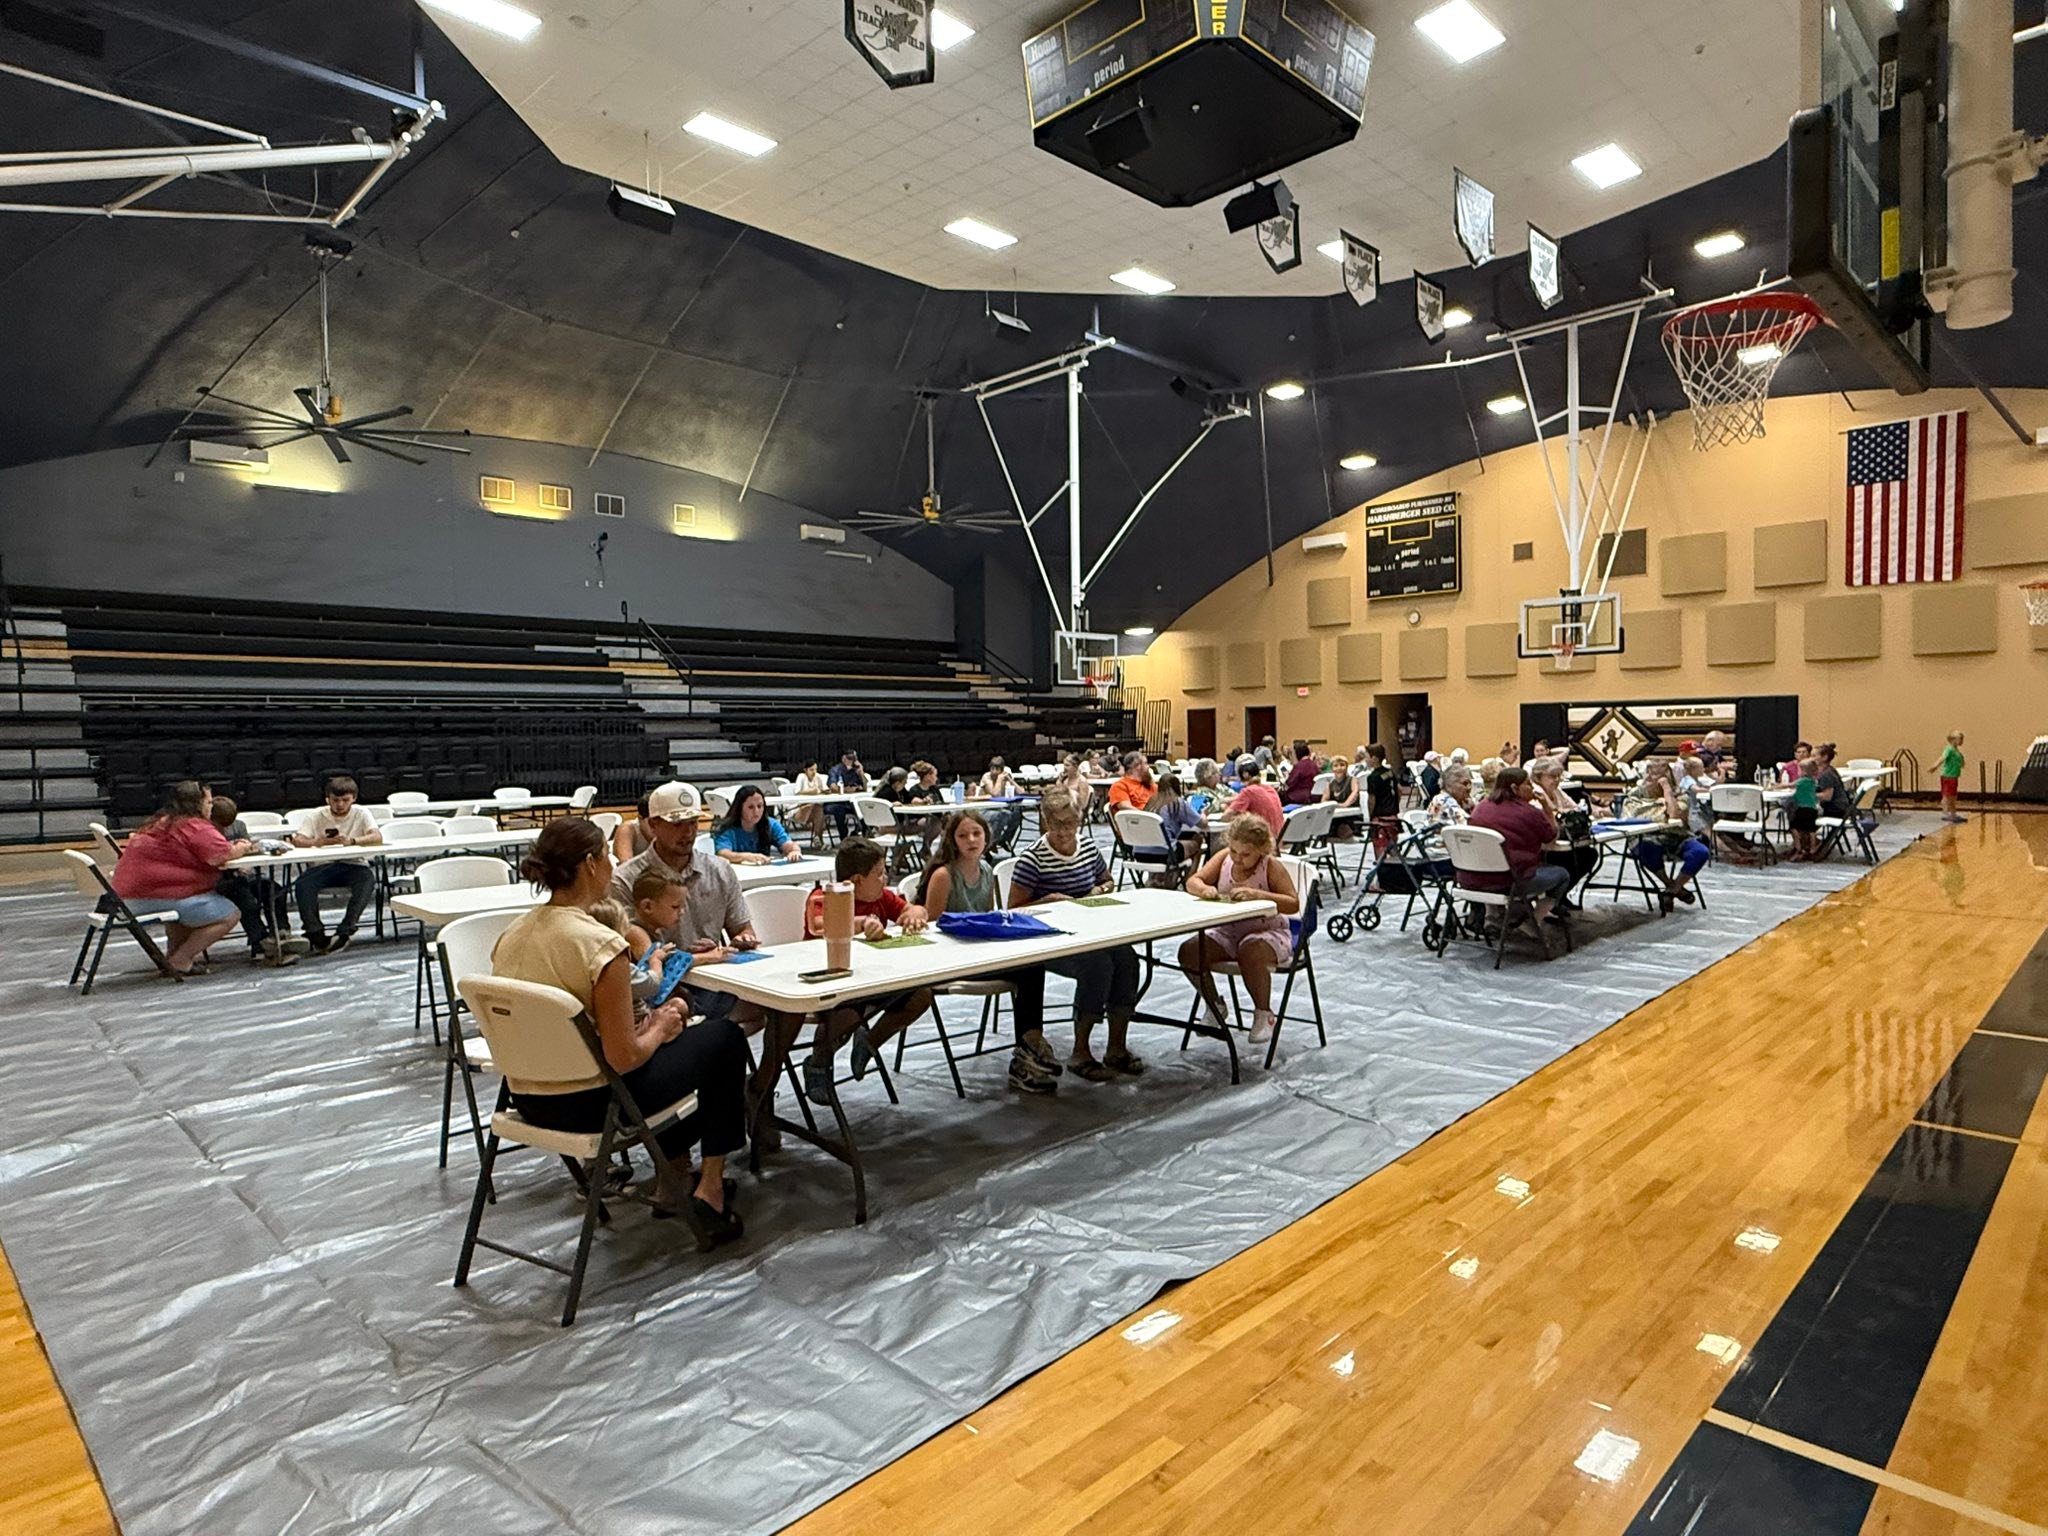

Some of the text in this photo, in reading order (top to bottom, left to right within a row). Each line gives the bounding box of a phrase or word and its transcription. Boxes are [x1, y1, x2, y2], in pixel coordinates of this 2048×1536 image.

[1211, 0, 1227, 35] ER
[1094, 54, 1125, 88] period
[1422, 505, 1442, 516] SEED
[1656, 708, 1713, 718] FOWLER
